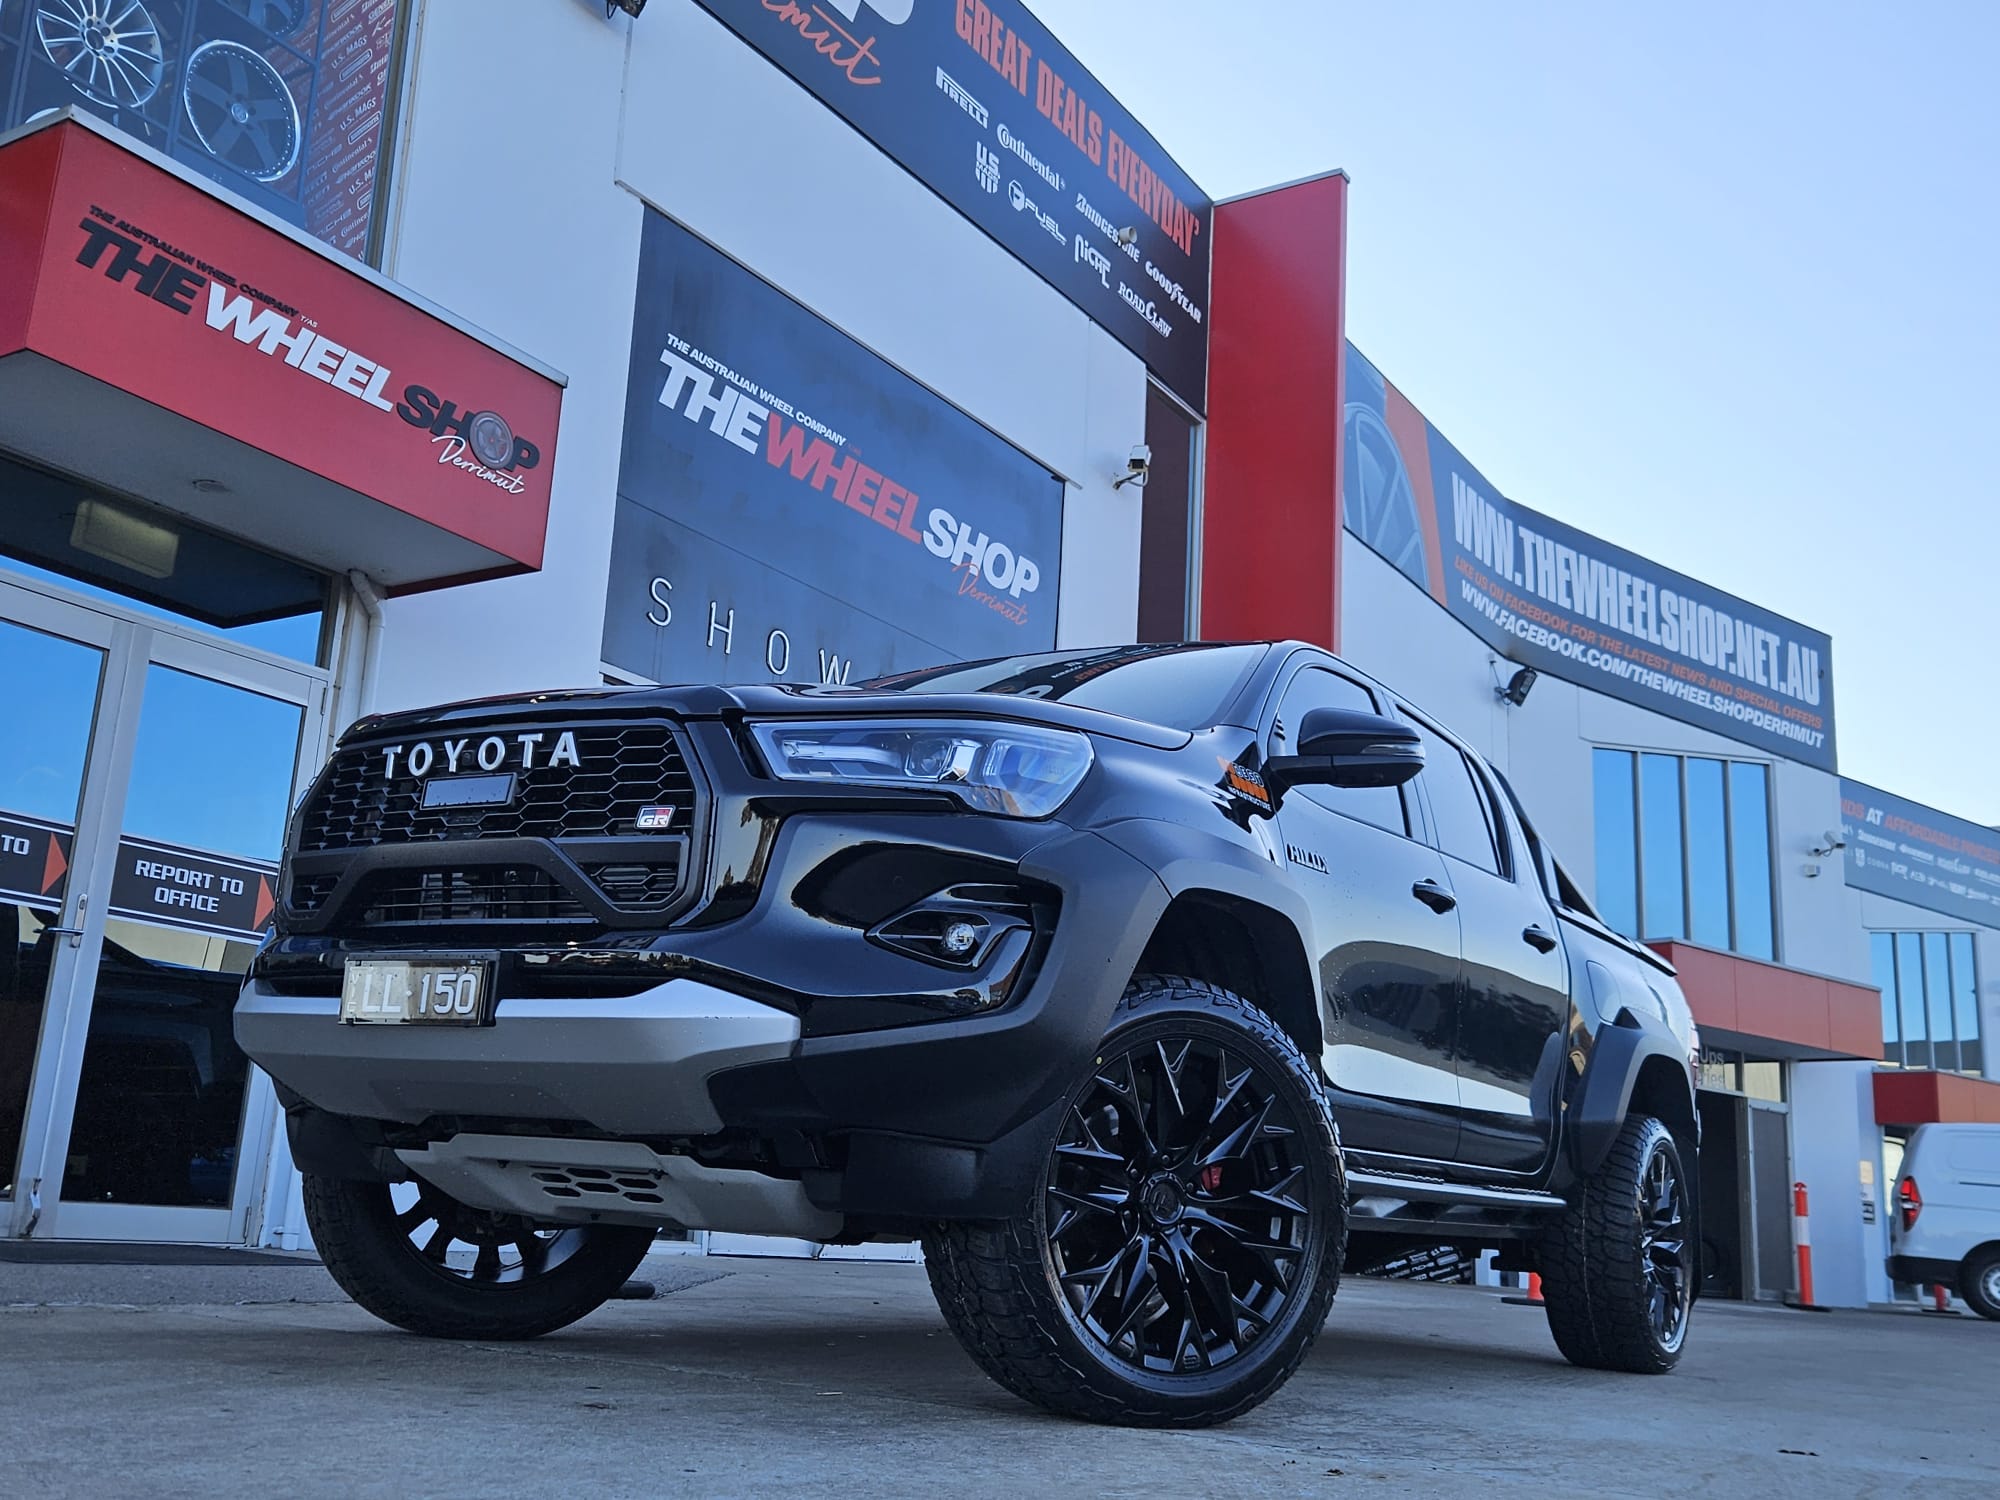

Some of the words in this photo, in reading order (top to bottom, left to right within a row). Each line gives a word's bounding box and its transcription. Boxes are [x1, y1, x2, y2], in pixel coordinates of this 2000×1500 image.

[955, 0, 1032, 97] GREAT
[1036, 58, 1103, 167] DEALS
[936, 65, 990, 129] PIRELLI
[1145, 260, 1202, 323] GOODYEAR
[1024, 197, 1067, 244] FUEL
[90, 204, 116, 225] THE
[115, 218, 195, 267] AUSTRALIAN
[196, 259, 238, 288] WHEEL
[239, 282, 299, 318] COMPANY
[76, 217, 207, 316] THE
[205, 281, 394, 413] WHEEL
[667, 332, 690, 355] THE
[690, 349, 759, 396] AUSTRALIAN
[759, 388, 795, 418] WHEEL
[795, 411, 847, 446] COMPANY
[431, 434, 525, 495] Derrimut
[658, 349, 770, 455] THE
[766, 412, 922, 545] WHEEL
[922, 508, 1041, 600] SHOP
[1451, 472, 1821, 706] WWW.THEWHEELSHOP.NET.AU
[1475, 572, 1488, 591] US
[1504, 592, 1570, 634] FACEBOOK
[1570, 625, 1596, 643] FOR
[1599, 635, 1623, 654] THE
[1624, 643, 1671, 671] LATEST
[1671, 662, 1707, 687] NEWS
[1708, 678, 1733, 696] AND
[1735, 687, 1780, 714] SPECIAL
[1783, 705, 1823, 729] OFFERS
[382, 731, 582, 780] TOYOTA
[1, 834, 30, 856] TO
[1865, 807, 1884, 826] AT
[135, 859, 215, 889] REPORT
[220, 876, 244, 896] TO
[154, 886, 220, 913] OFFICE
[419, 973, 477, 1015] 150
